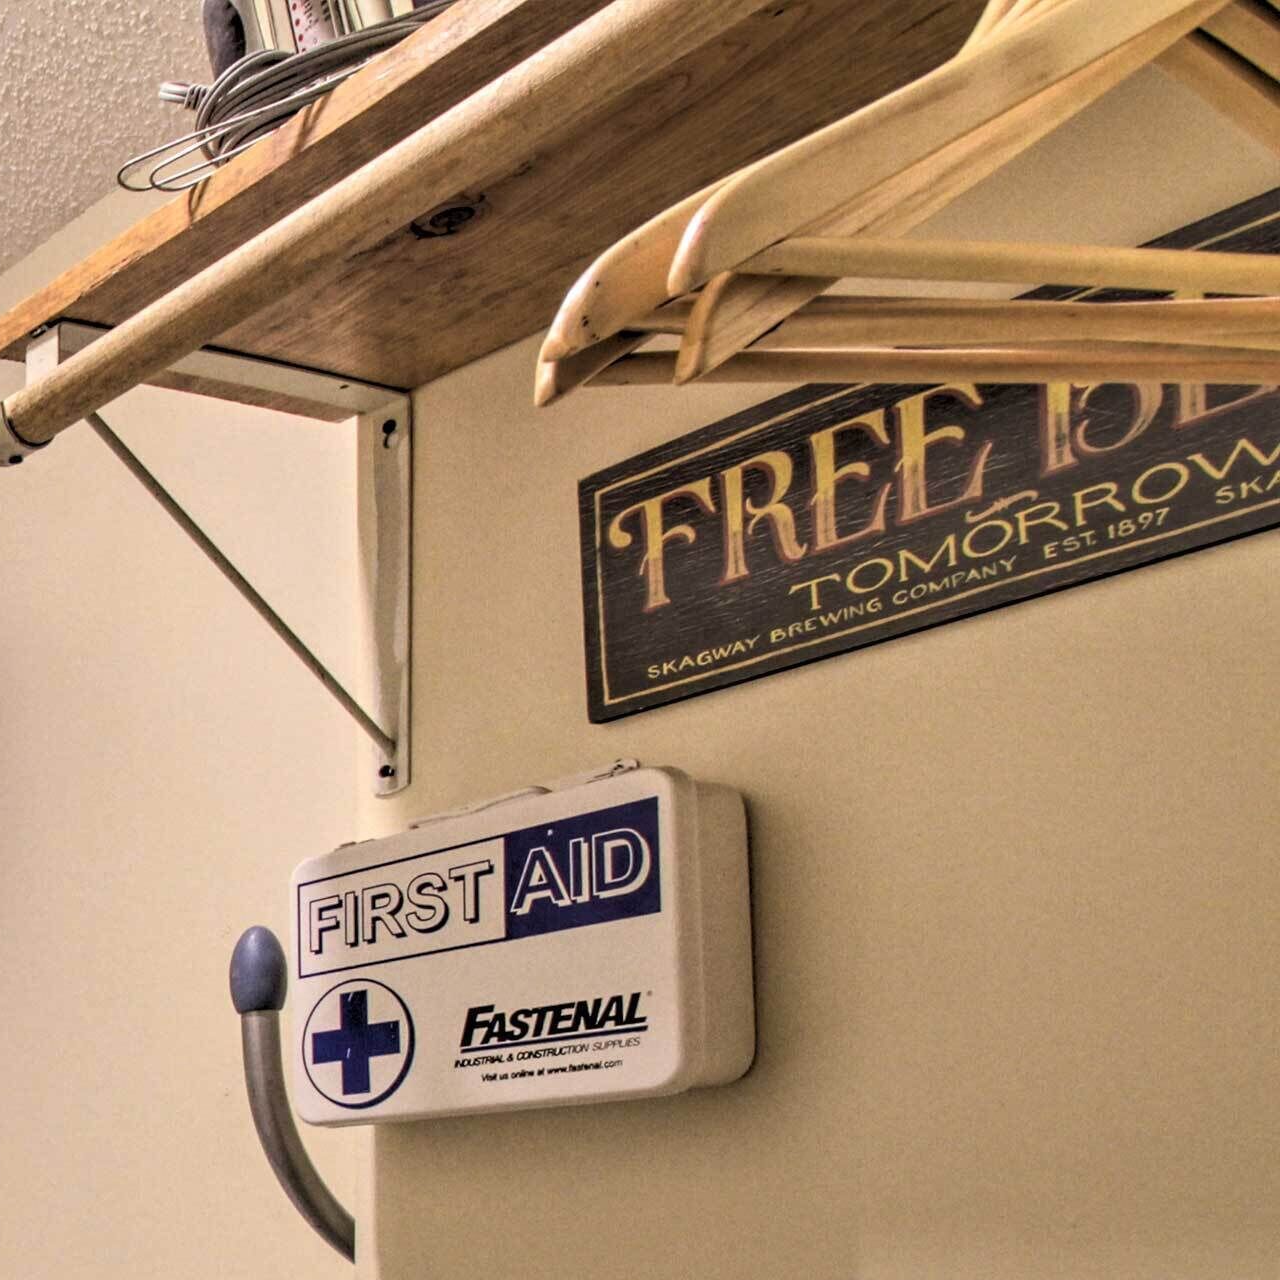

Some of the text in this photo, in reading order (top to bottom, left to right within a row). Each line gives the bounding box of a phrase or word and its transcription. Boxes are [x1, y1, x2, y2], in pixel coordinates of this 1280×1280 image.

[607, 383, 993, 612] FREE
[789, 438, 1280, 610] TOMORROW
[647, 635, 760, 679] SKAGWAY
[770, 597, 883, 643] BREWING
[892, 555, 1017, 604] COMPANY
[1107, 507, 1171, 539] 1897
[309, 828, 653, 954] FIRST AID
[454, 1036, 641, 1068] INDUSTRIAL & CONSTRUCTION SUPPLIES
[460, 992, 647, 1047] FASTENAL
[481, 1071, 497, 1082] Visit
[499, 1072, 509, 1081] us
[511, 1067, 534, 1079] online
[537, 1066, 545, 1076] at
